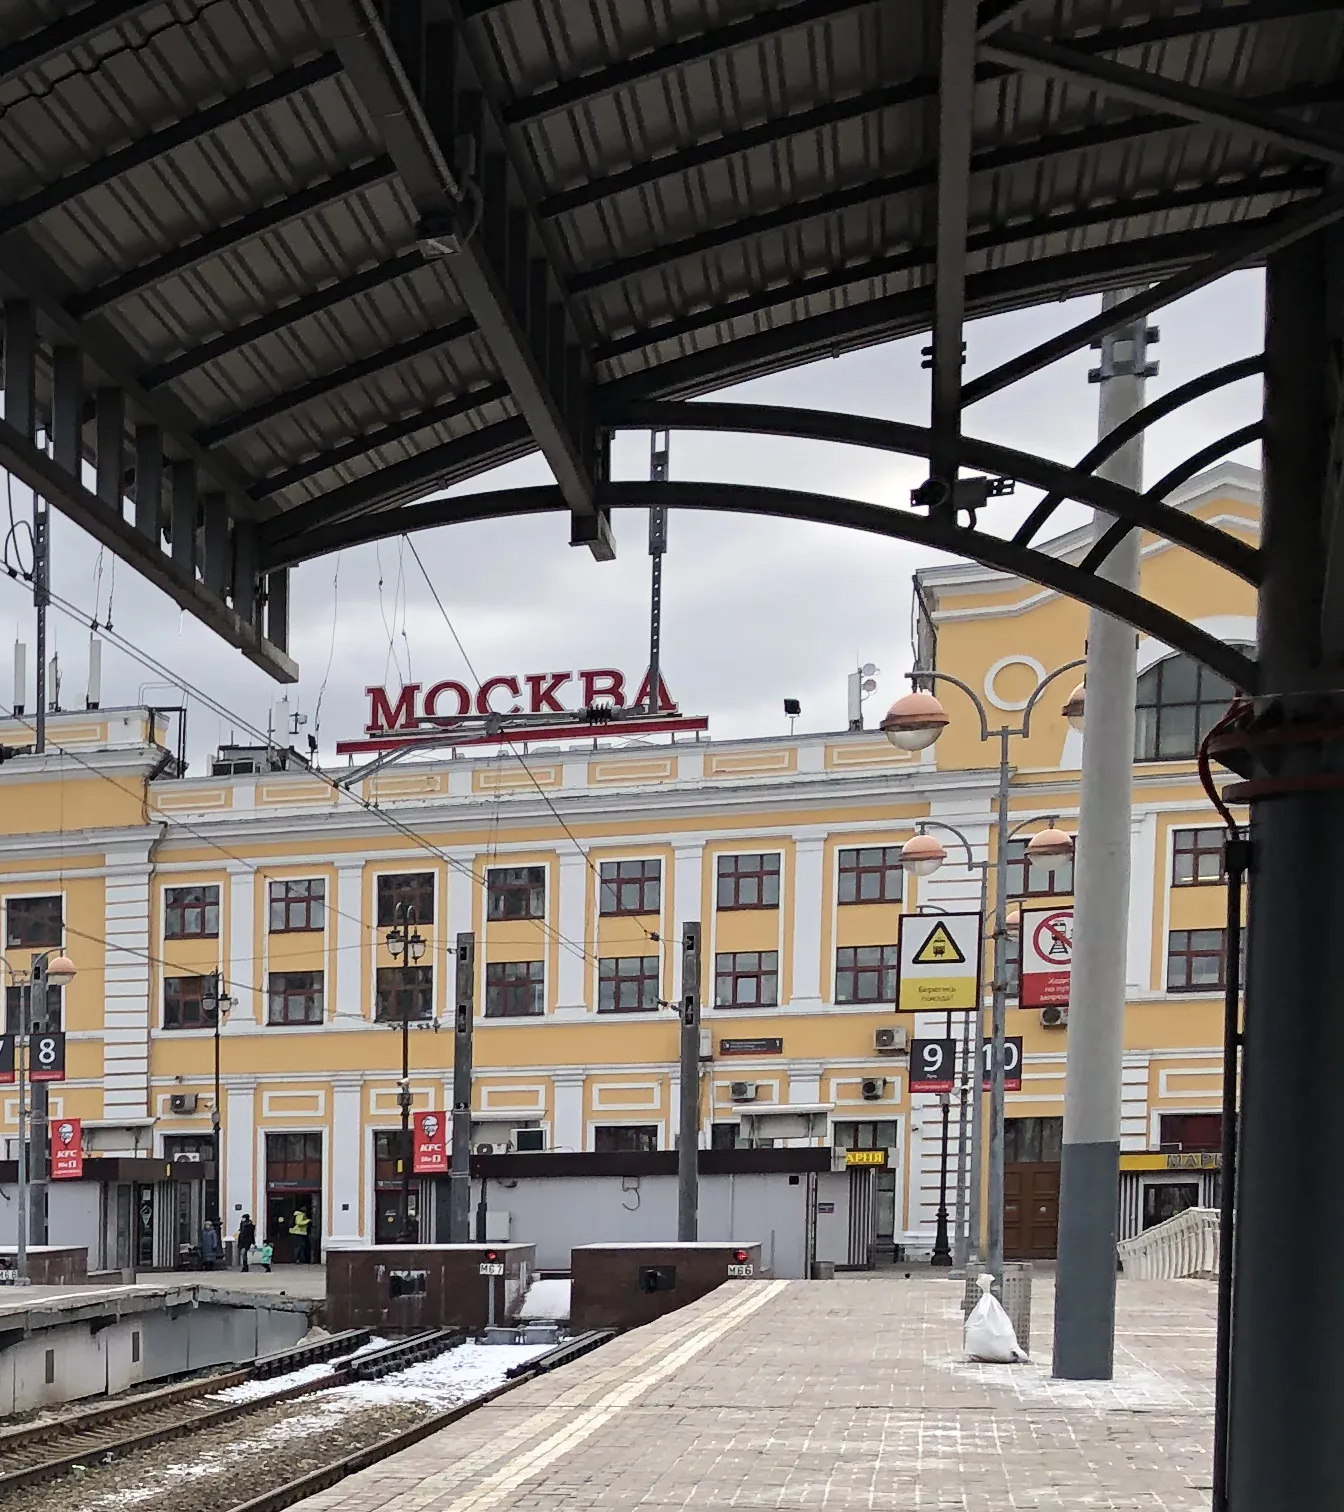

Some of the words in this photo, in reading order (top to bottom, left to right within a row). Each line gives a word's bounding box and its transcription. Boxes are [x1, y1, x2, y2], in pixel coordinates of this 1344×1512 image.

[364, 665, 680, 735] МОСКВА
[38, 1038, 56, 1064] 8
[922, 1043, 943, 1072] 9
[982, 1042, 1019, 1071] 10
[56, 1149, 78, 1158] KFC
[420, 1143, 442, 1152] KFC
[481, 1264, 502, 1274] М67
[729, 1266, 752, 1275] М66
